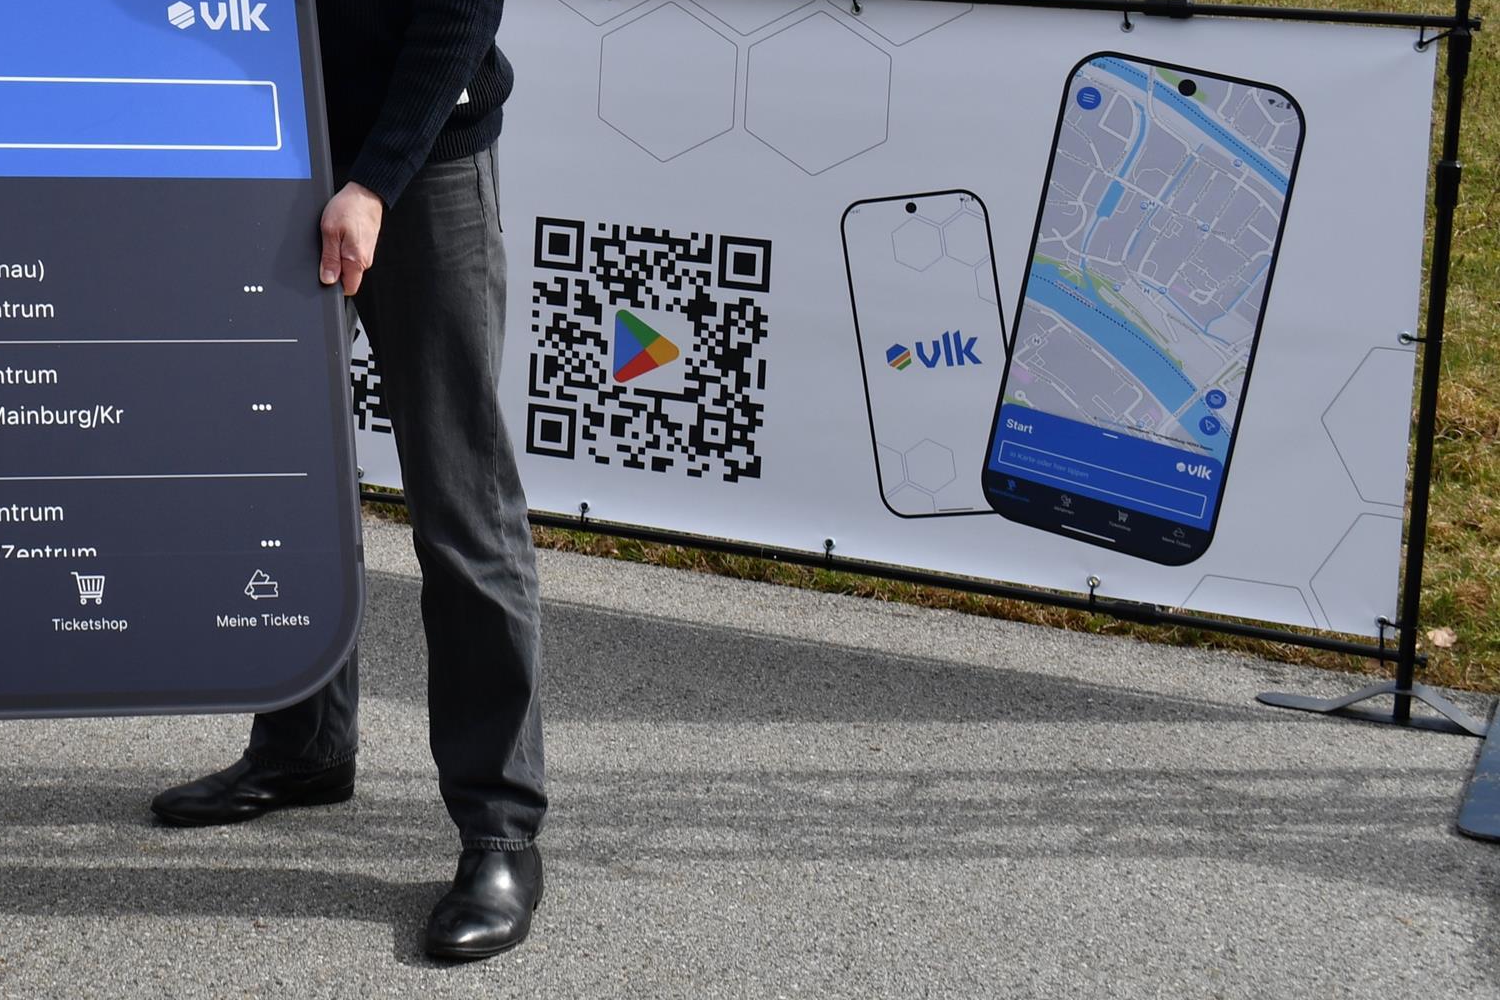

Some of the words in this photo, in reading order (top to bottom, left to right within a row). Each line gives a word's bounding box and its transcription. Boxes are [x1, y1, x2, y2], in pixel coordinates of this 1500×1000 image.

[915, 329, 982, 369] vlk
[1006, 418, 1033, 434] Start
[1188, 464, 1212, 480] vlk
[51, 617, 128, 633] Ticketshop
[216, 614, 258, 628] Meine
[261, 613, 310, 628] Tickets
